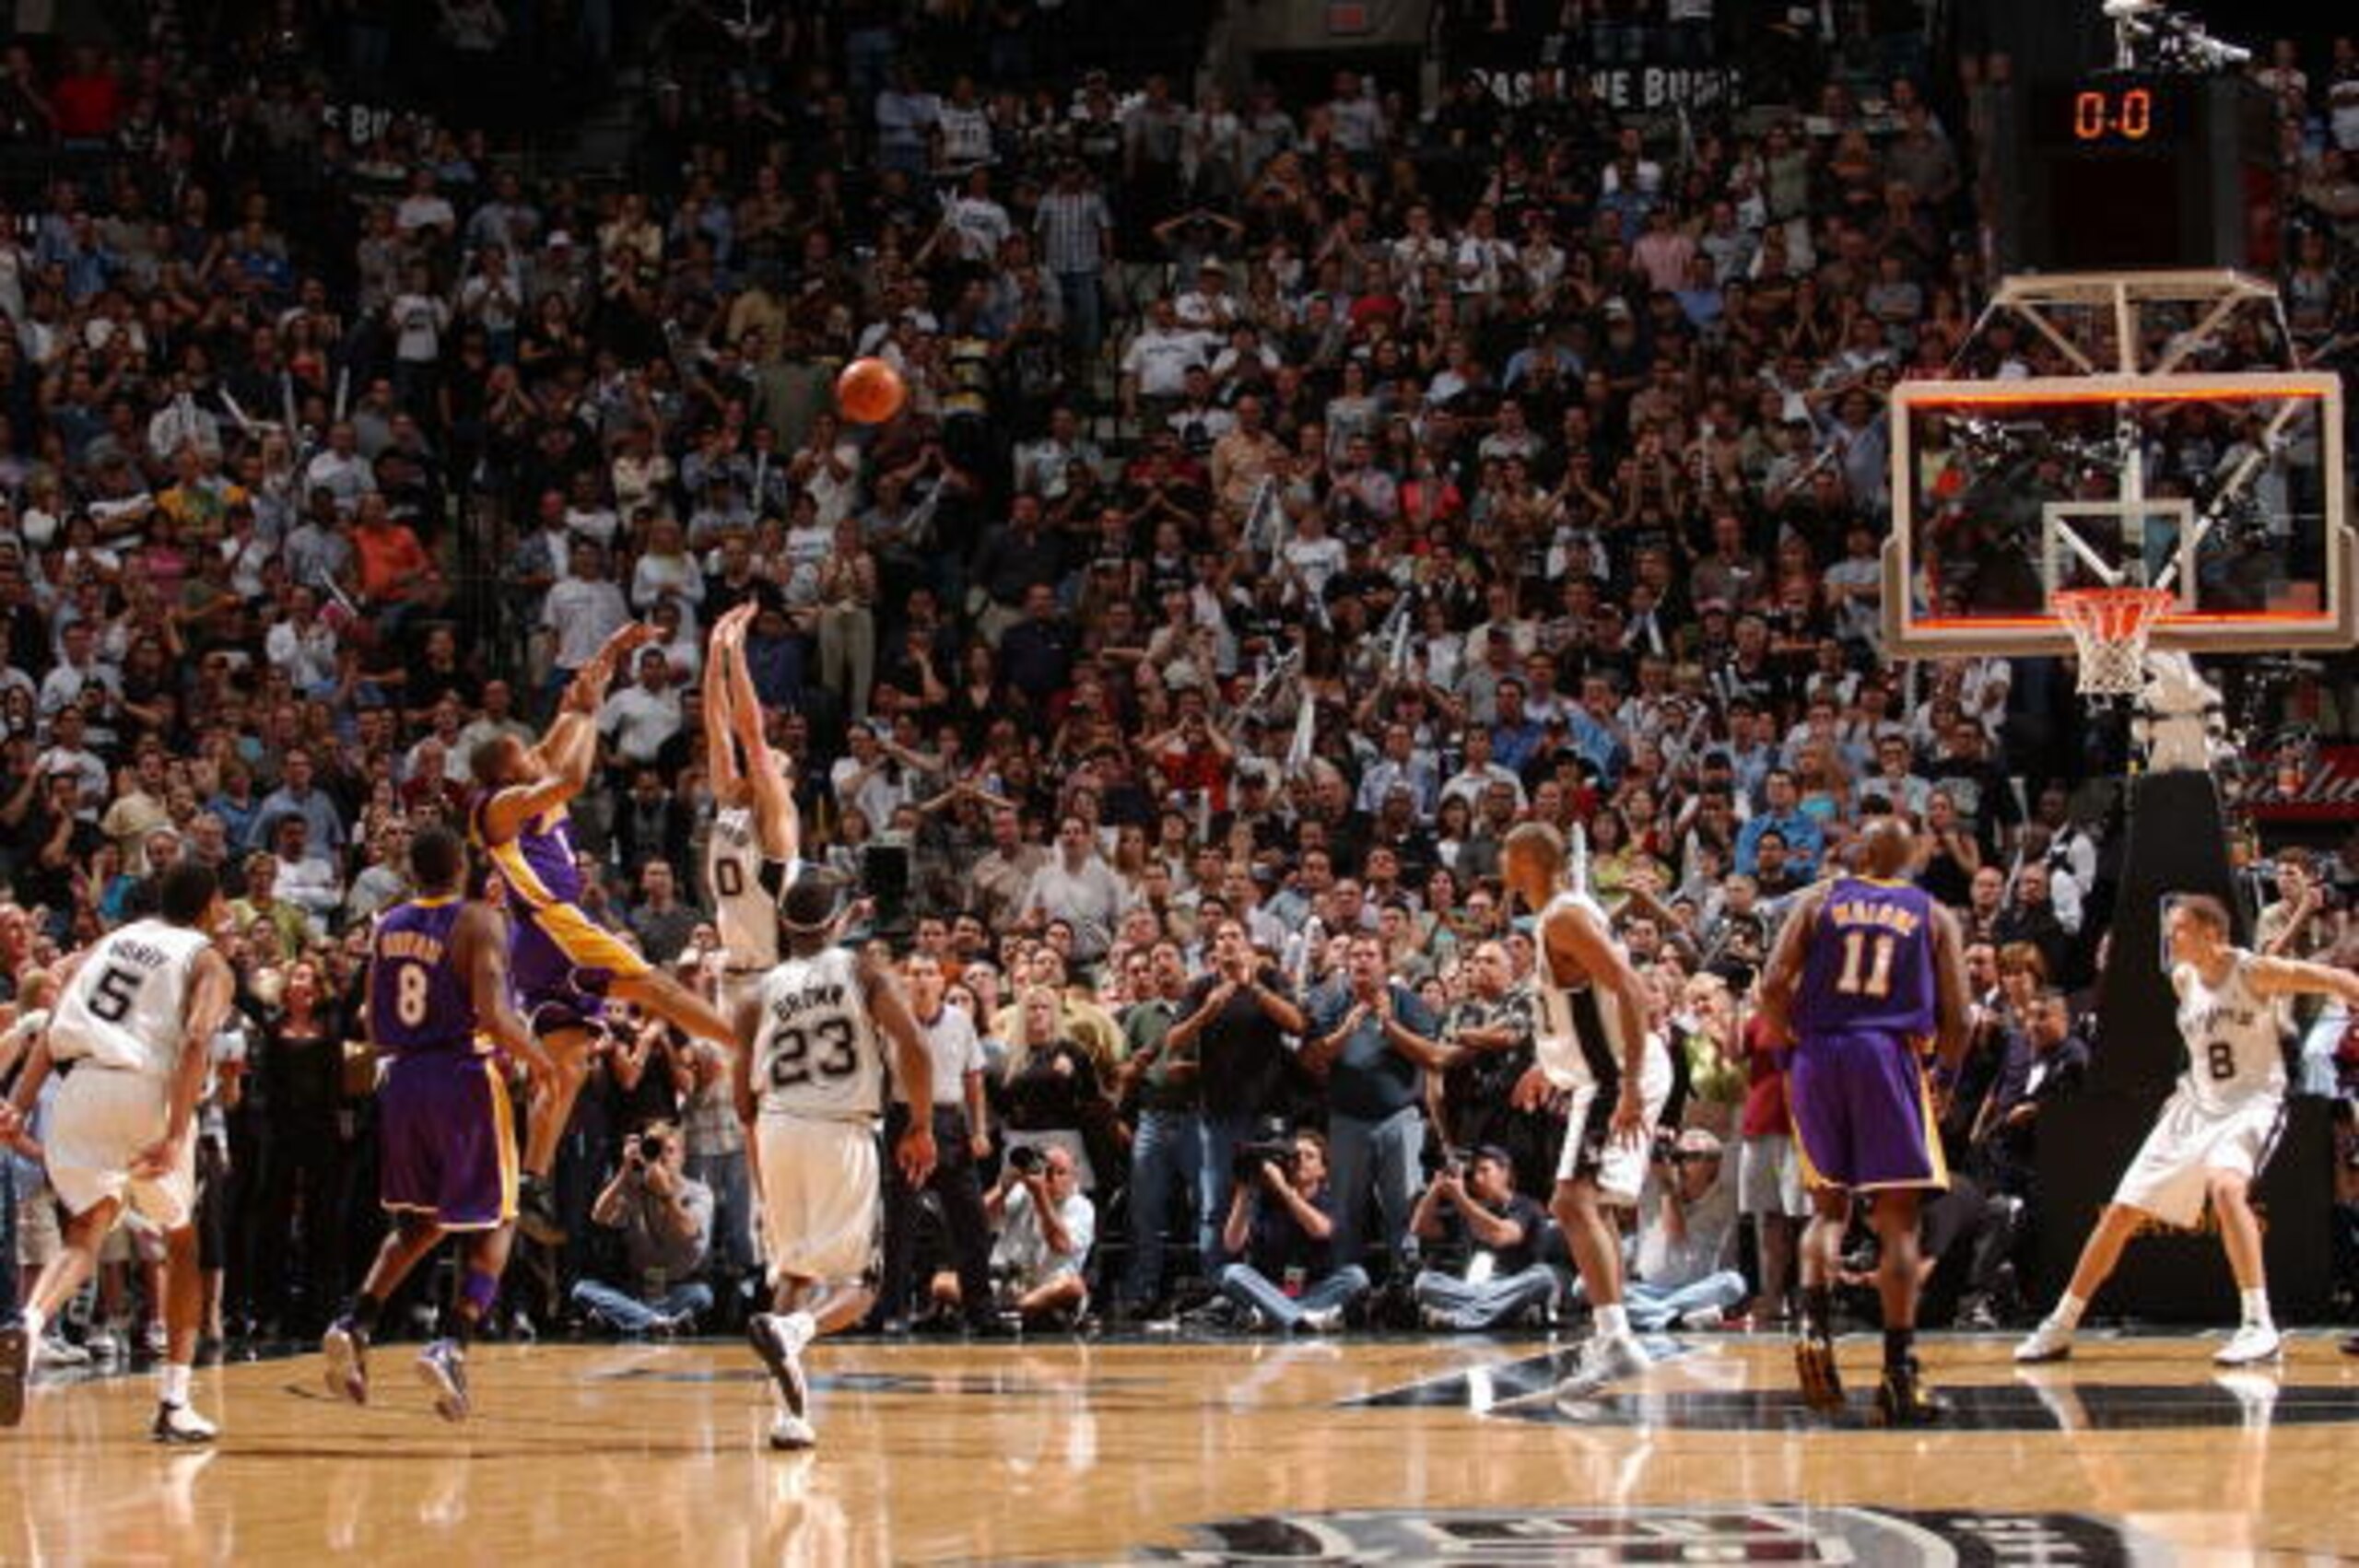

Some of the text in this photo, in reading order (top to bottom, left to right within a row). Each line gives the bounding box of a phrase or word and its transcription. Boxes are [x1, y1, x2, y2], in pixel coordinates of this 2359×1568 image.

[88, 965, 143, 1022] 5
[397, 962, 427, 1026] 8
[1837, 932, 1895, 996] 11
[773, 983, 845, 1022] BROWN
[771, 1015, 857, 1087] 23
[2208, 1041, 2236, 1080] 8
